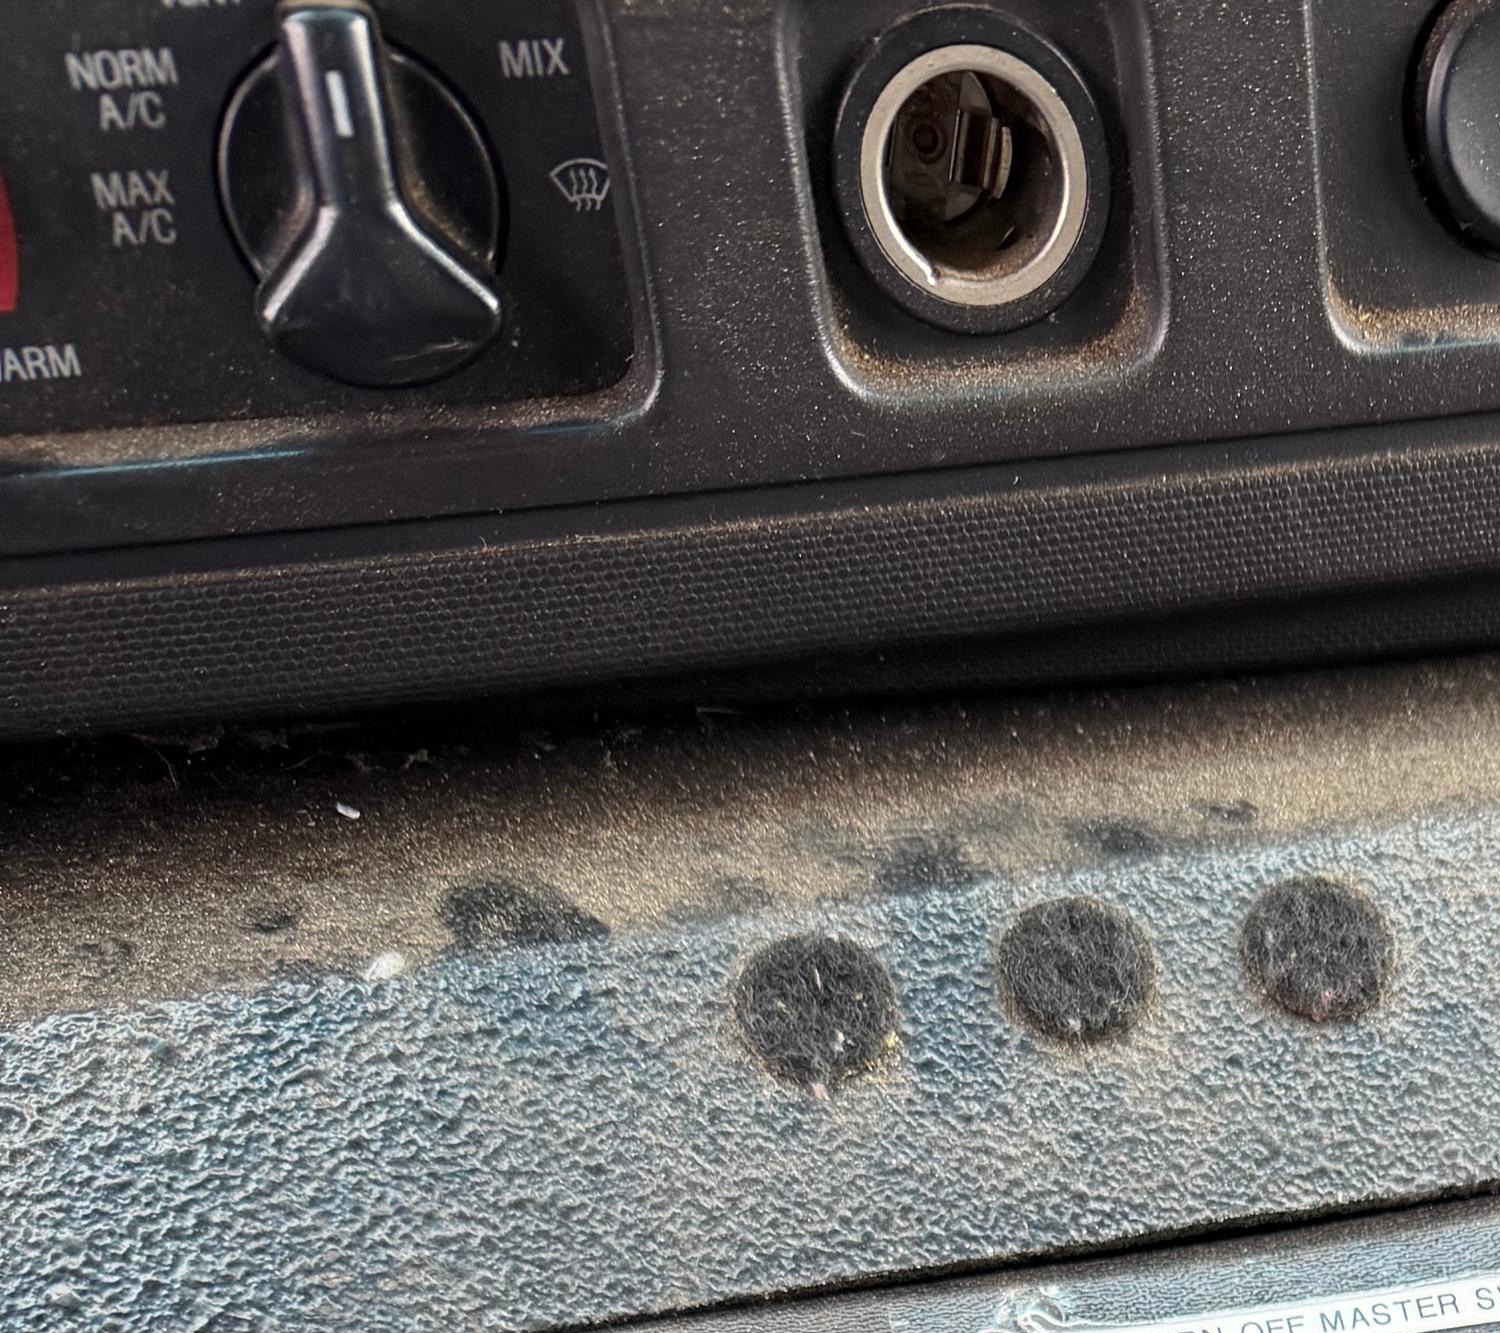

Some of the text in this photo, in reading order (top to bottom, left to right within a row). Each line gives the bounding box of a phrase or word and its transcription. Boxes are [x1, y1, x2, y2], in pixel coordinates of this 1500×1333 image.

[65, 47, 179, 91] NORM
[499, 38, 571, 79] MIX
[99, 91, 167, 131] A/C
[91, 169, 176, 211] MAX
[111, 209, 178, 248] A/C
[0, 343, 82, 382] ARM
